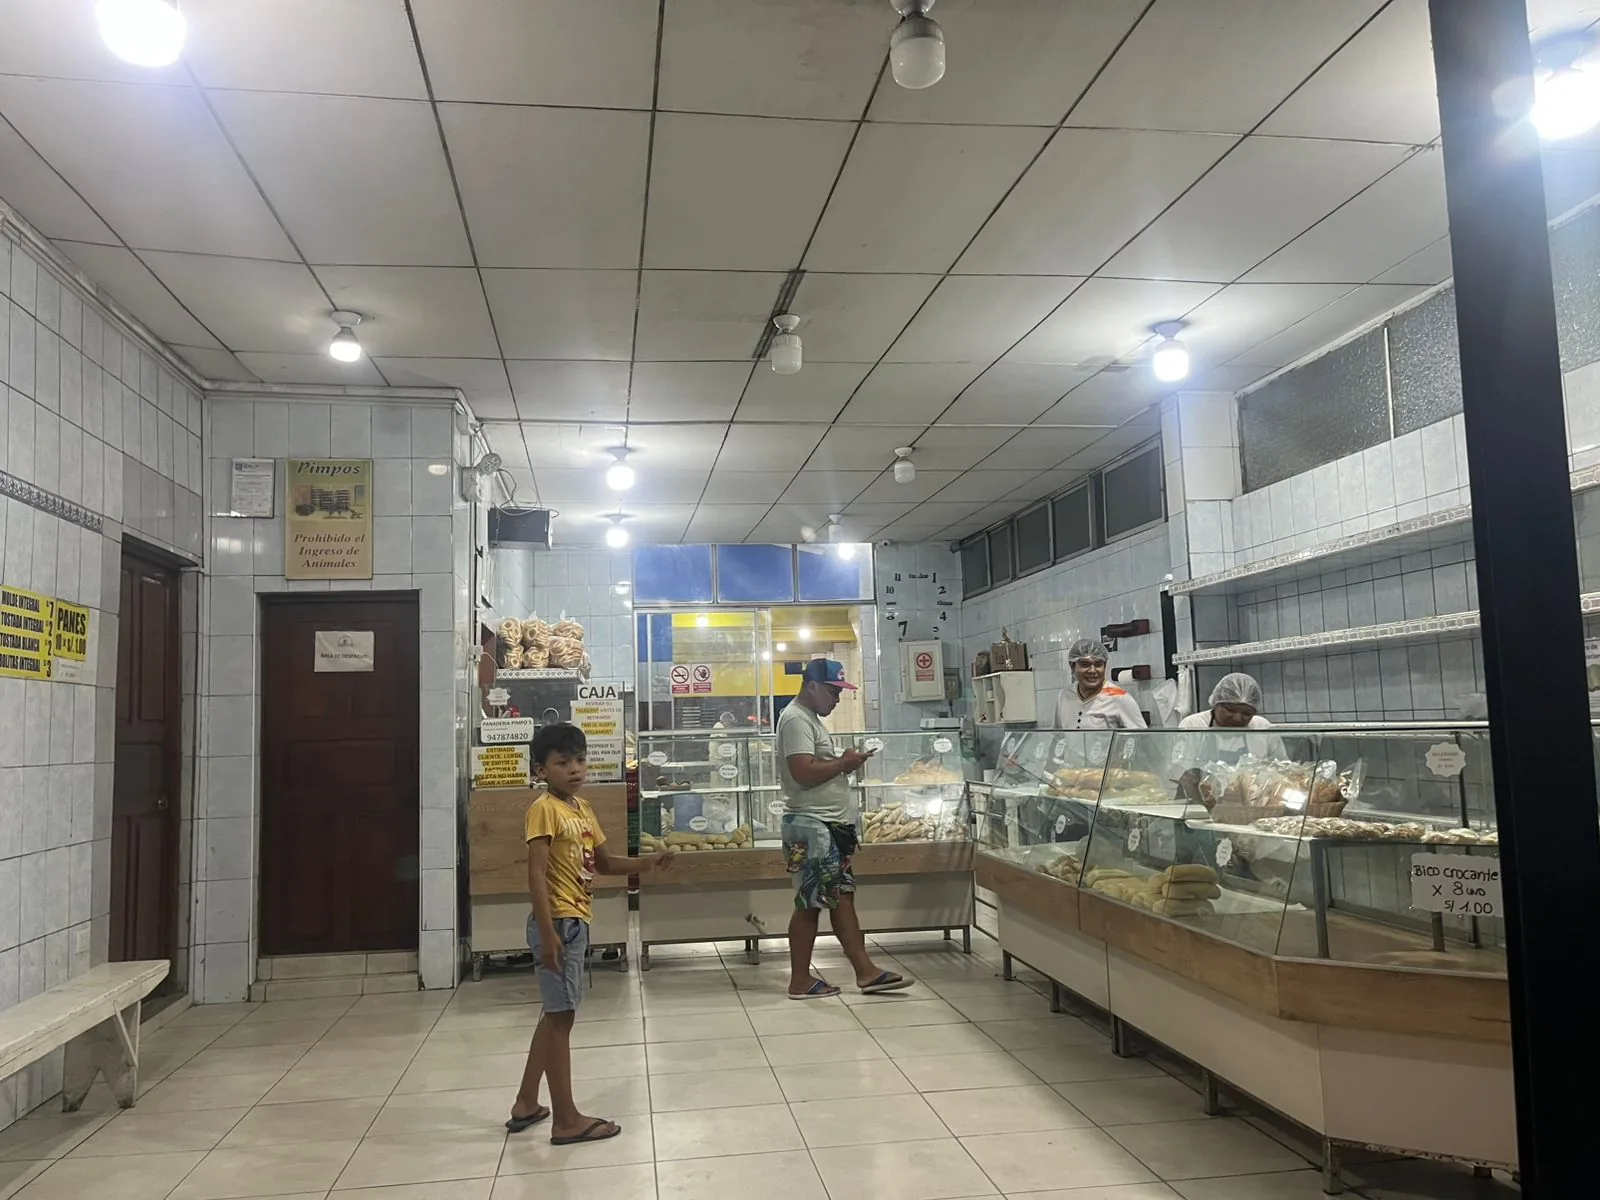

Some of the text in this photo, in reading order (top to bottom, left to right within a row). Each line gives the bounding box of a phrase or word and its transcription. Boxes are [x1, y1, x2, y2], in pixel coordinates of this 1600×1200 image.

[298, 462, 361, 476] Pimpos
[294, 533, 365, 543] Prohibido el
[298, 546, 360, 557] Ingreso de
[302, 559, 356, 568] Animales
[886, 586, 895, 594] 10
[938, 586, 947, 594] 2
[57, 607, 86, 636] PANES
[940, 611, 947, 621] 4
[898, 621, 908, 636] 7
[579, 686, 616, 699] CAJA
[487, 732, 528, 742] 947874820
[1413, 864, 1498, 882] Bico crocante
[1452, 881, 1464, 896] 8
[1459, 900, 1493, 915] 1.00
